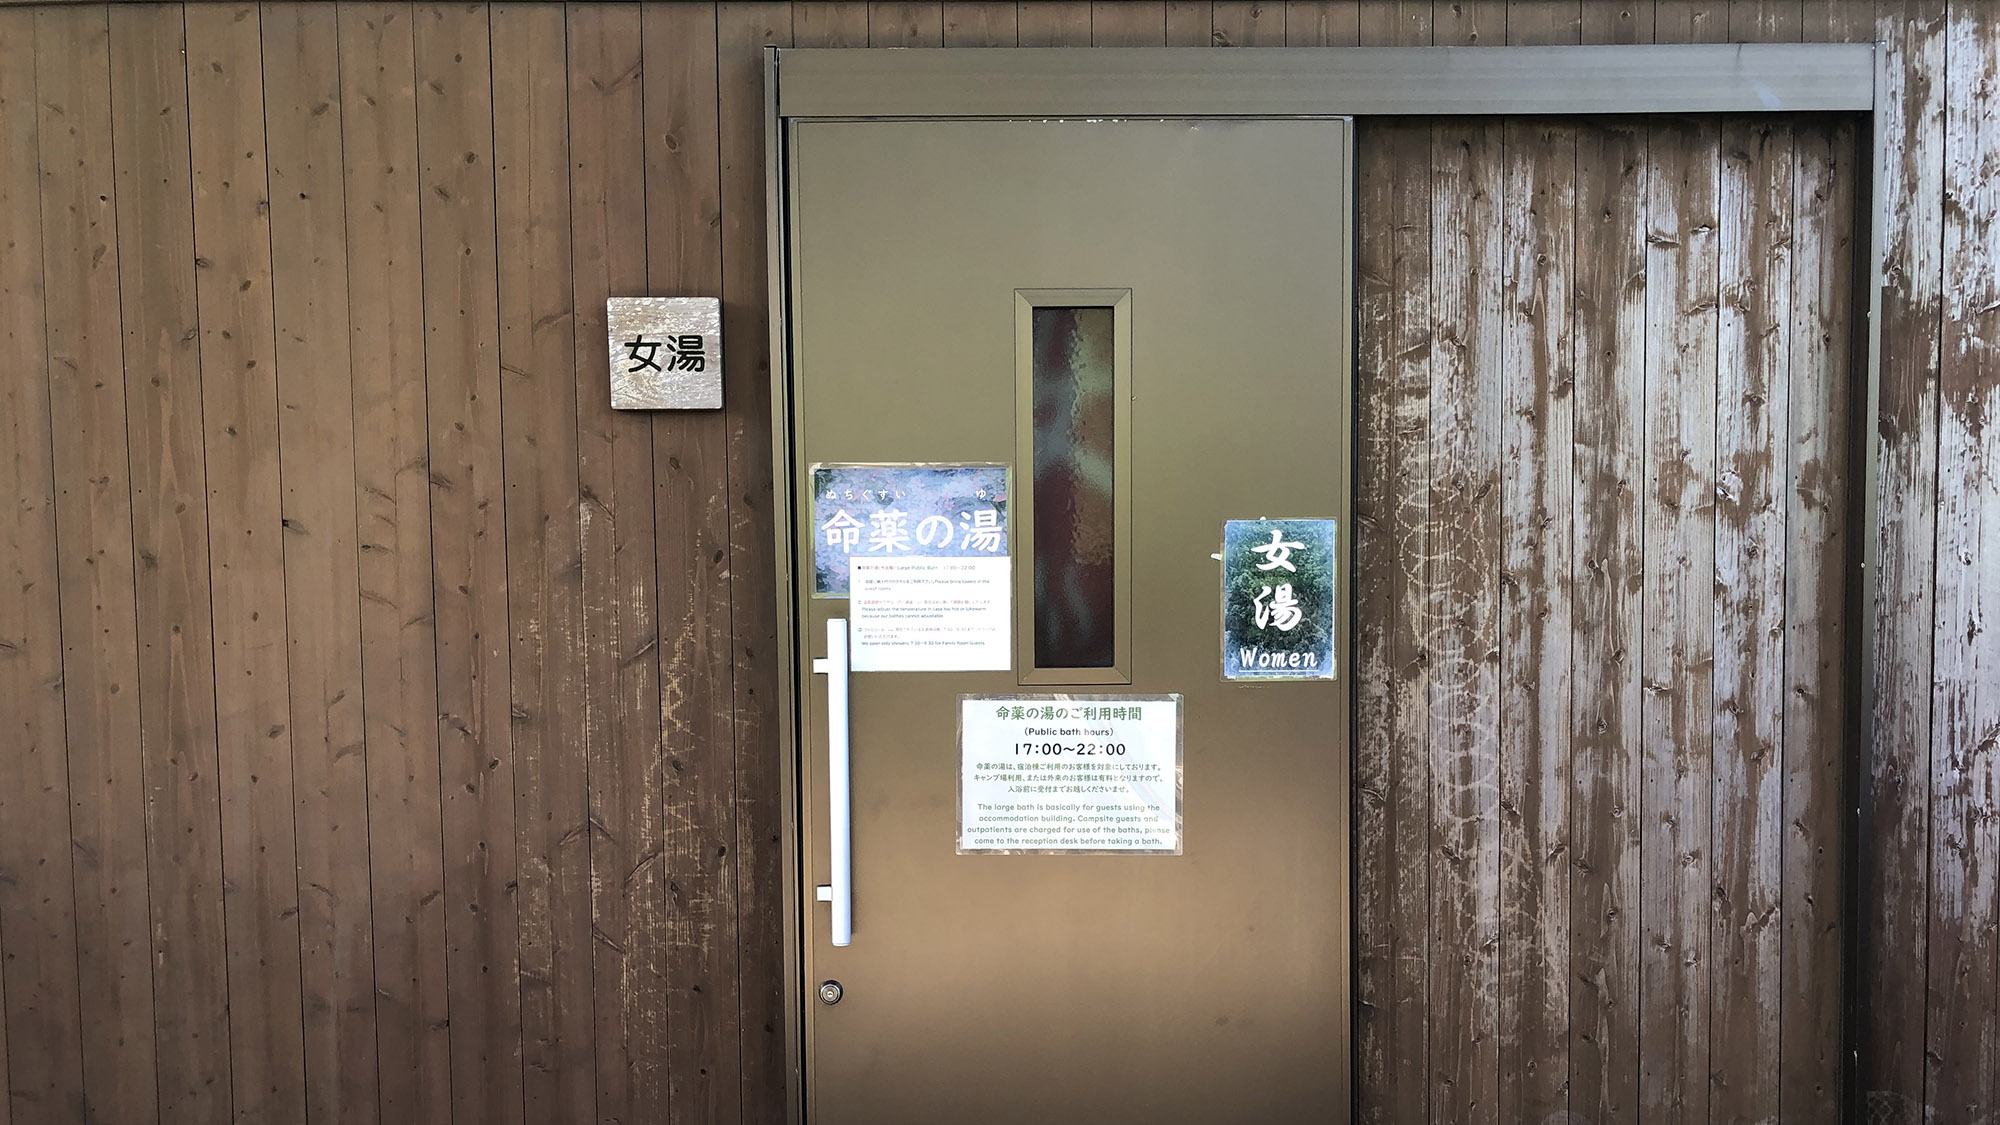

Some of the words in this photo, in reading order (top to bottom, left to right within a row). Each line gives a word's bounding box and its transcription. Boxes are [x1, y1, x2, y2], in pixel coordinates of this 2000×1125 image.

[624, 334, 705, 372] 女湯
[825, 489, 906, 500] ぬちぐすい
[976, 488, 987, 500] ゆ
[821, 508, 1002, 553] 命薬の湯
[1251, 529, 1305, 632] 女湯
[1240, 647, 1318, 668] Women
[995, 705, 1142, 720] 命薬の湯のご利用時間
[1024, 727, 1057, 736] (Public
[1060, 727, 1081, 736] bath
[1084, 727, 1114, 736] hours)
[994, 804, 1015, 812] large
[1045, 804, 1080, 812] basically
[1096, 804, 1121, 812] guests
[1124, 804, 1145, 812] using
[1041, 815, 1076, 823] building.
[1077, 815, 1114, 823] Campsite
[1115, 815, 1141, 823] guests
[967, 826, 1012, 834] outpatients
[1029, 826, 1061, 834] charged
[1117, 826, 1143, 834] baths,
[1108, 838, 1133, 846] taking
